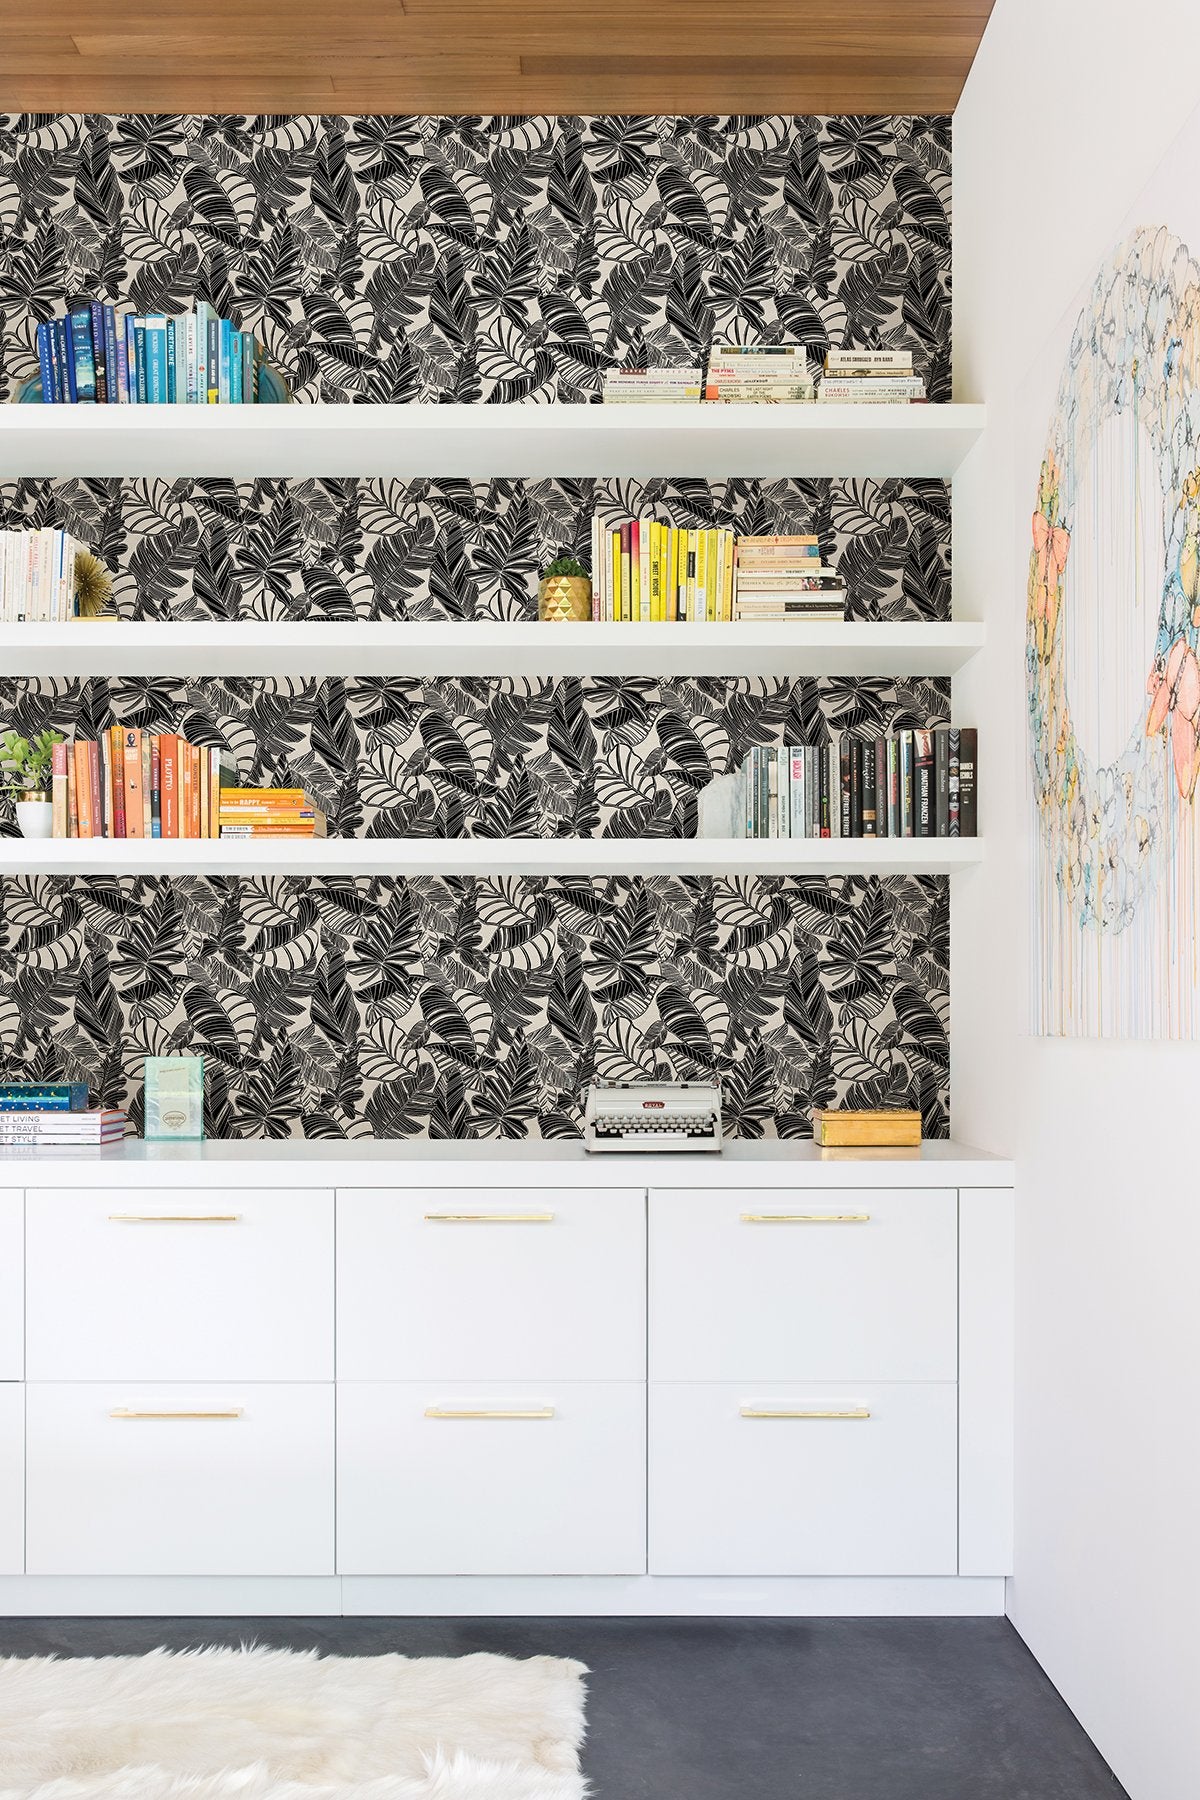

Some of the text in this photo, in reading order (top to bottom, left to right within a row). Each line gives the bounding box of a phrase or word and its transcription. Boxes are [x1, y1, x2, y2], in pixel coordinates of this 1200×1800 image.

[165, 758, 173, 791] PLOTTO
[862, 748, 871, 789] Mockingbird
[921, 769, 929, 824] JONATHAN FRANZEN
